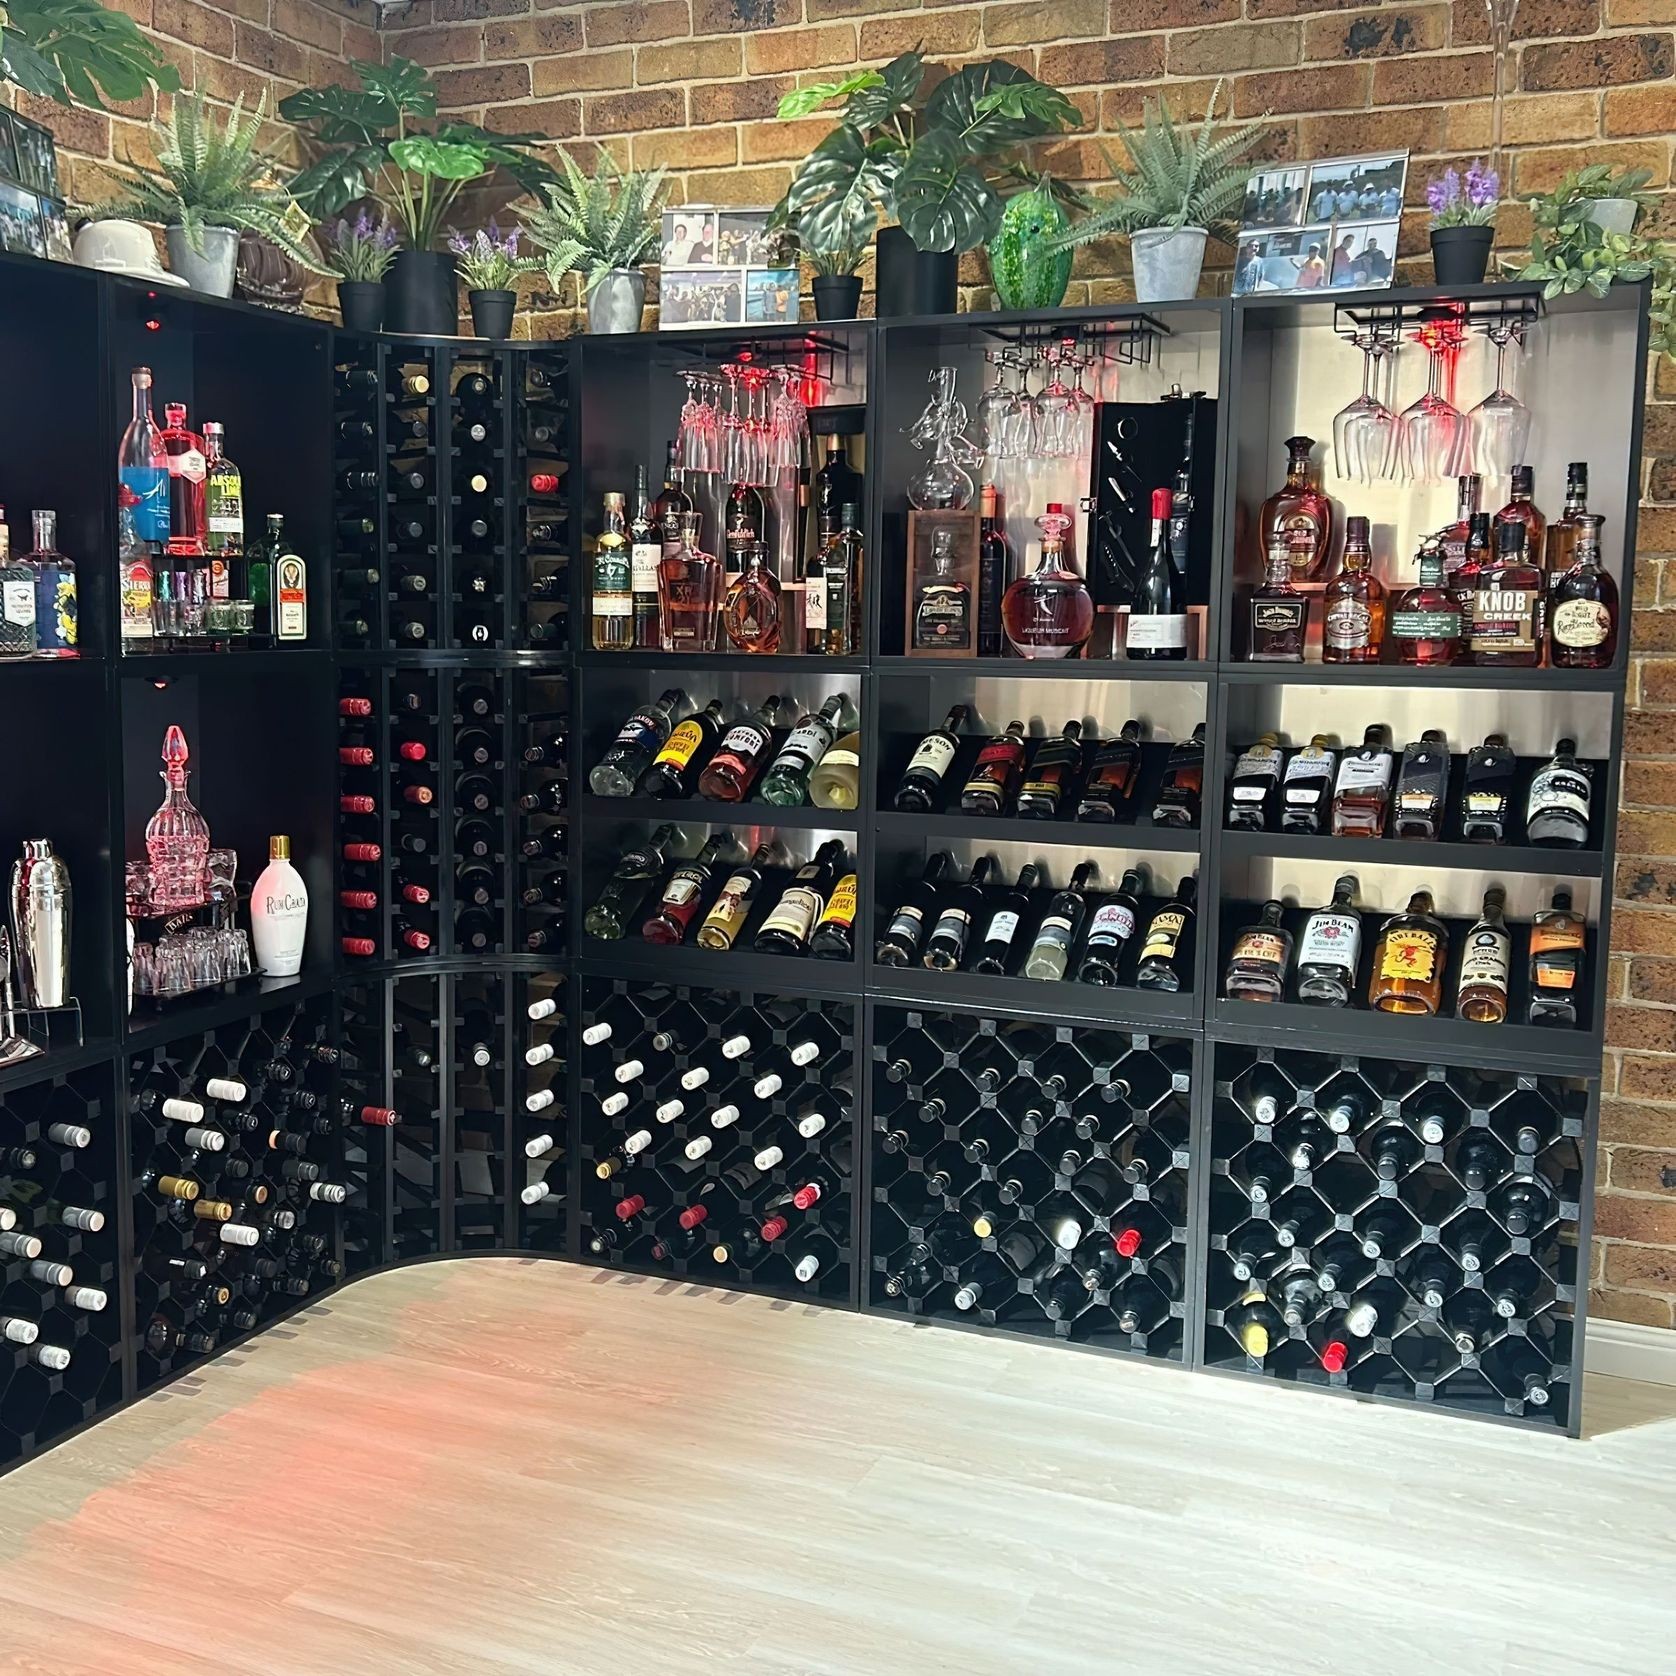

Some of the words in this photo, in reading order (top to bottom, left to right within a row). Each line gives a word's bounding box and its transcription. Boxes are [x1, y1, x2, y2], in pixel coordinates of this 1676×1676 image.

[1479, 592, 1527, 612] KNOB
[1483, 613, 1532, 621] CREEK
[1312, 920, 1330, 930] JIM
